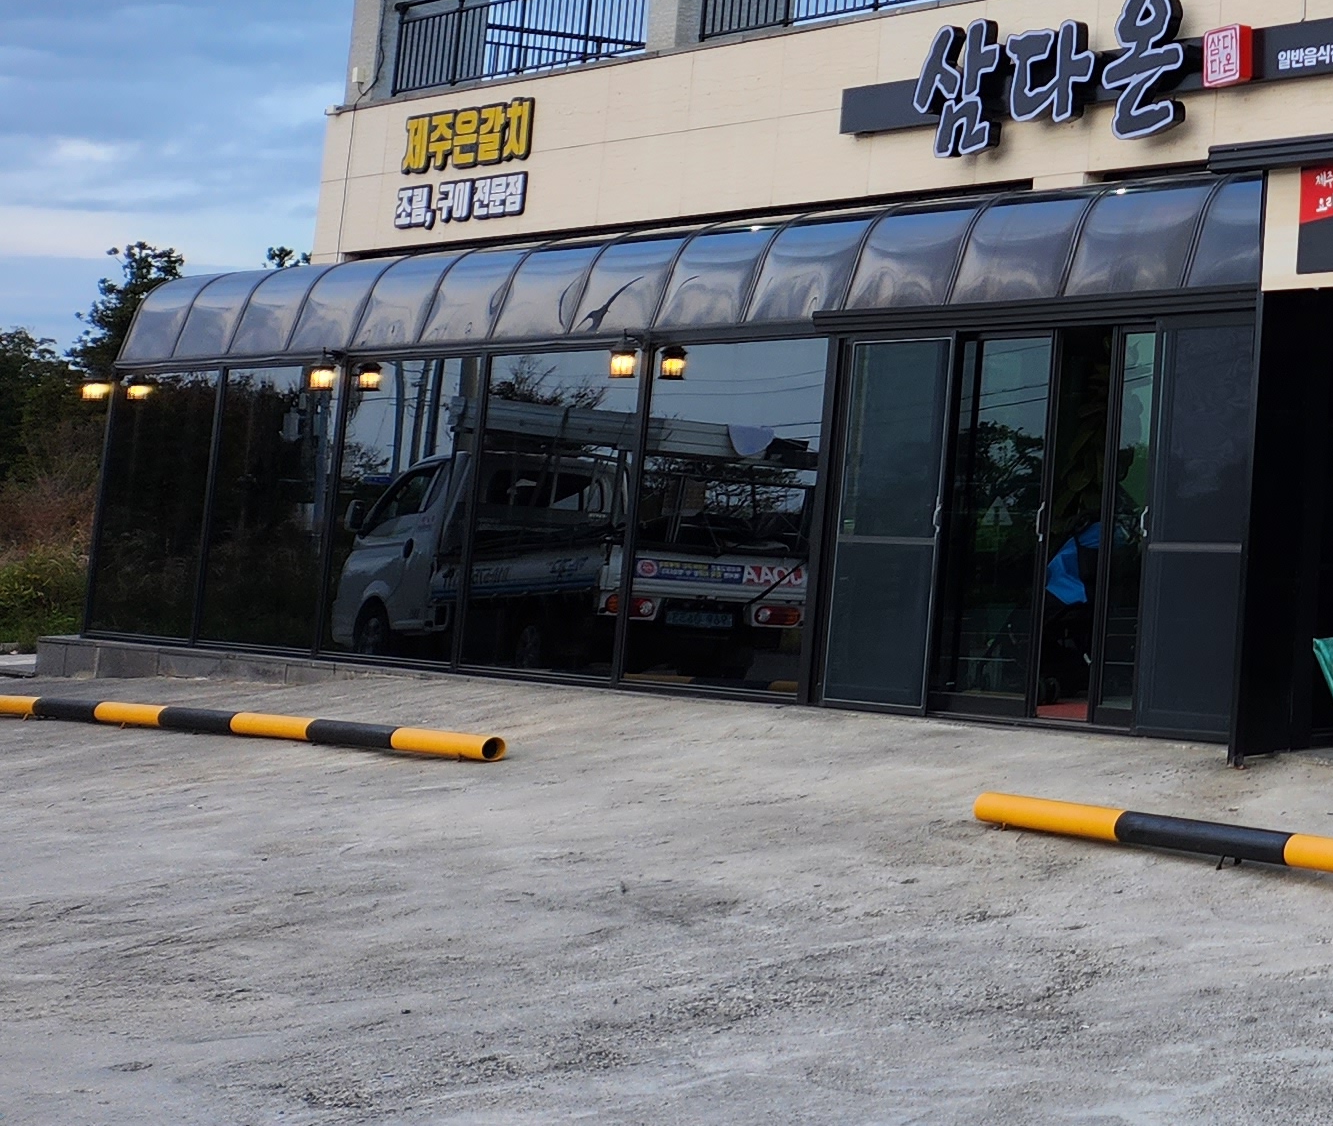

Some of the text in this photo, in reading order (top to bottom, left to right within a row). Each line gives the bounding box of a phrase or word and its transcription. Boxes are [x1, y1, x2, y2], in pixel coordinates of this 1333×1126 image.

[1208, 32, 1235, 57] 삼다
[1209, 53, 1235, 75] 다온
[402, 97, 535, 174] 제주은갈치
[395, 171, 528, 230] 조림, 구이 전문점
